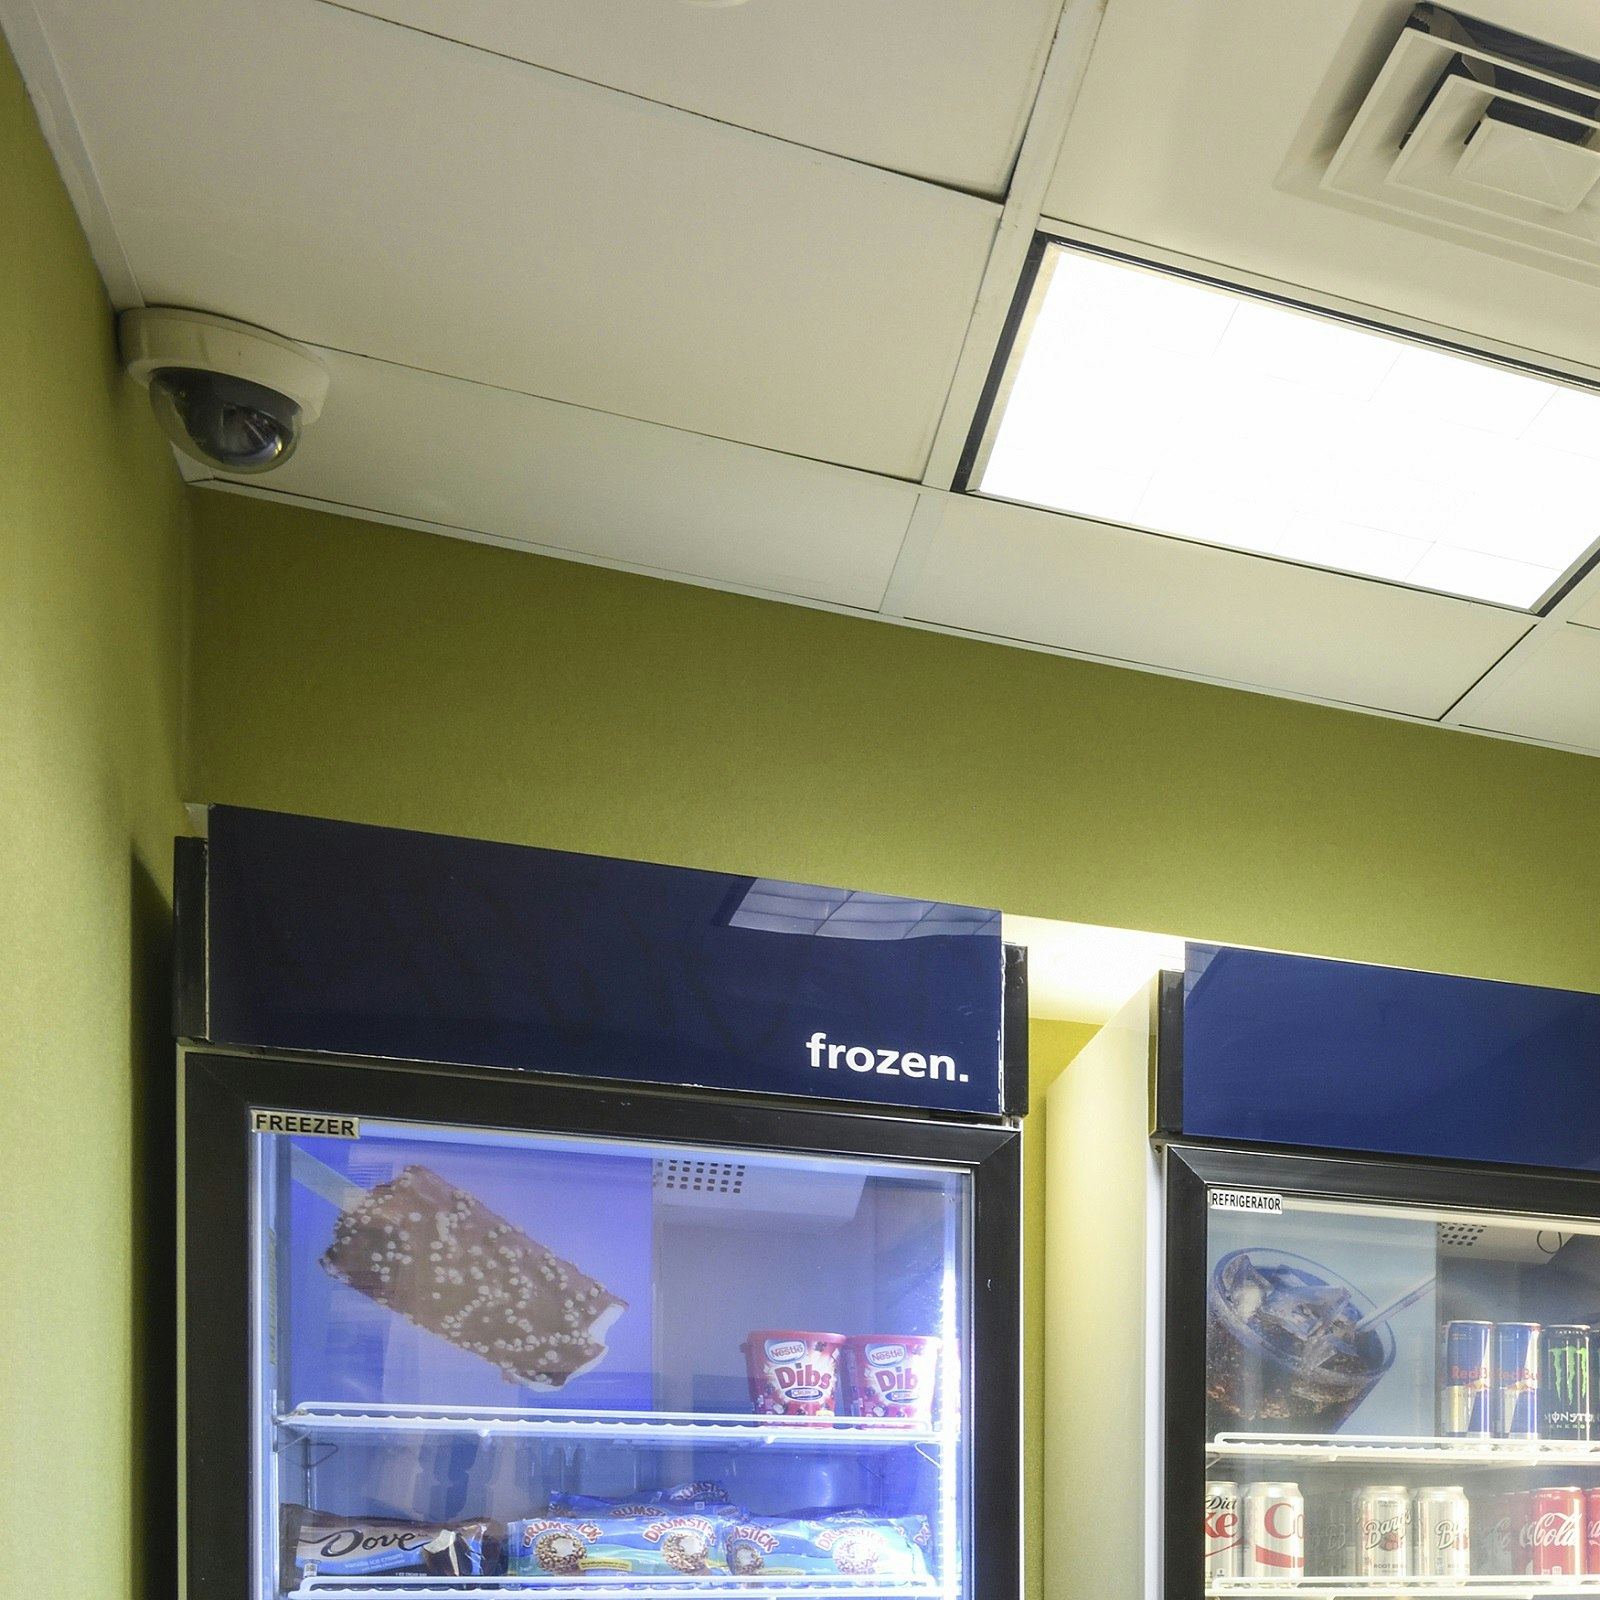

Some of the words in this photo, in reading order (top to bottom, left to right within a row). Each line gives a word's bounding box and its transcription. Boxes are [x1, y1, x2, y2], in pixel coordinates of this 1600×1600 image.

[805, 1032, 971, 1083] frozen.
[253, 1112, 357, 1137] FREEZER
[1211, 1191, 1282, 1213] REFRIGERATOR
[774, 1362, 833, 1390] Dibs
